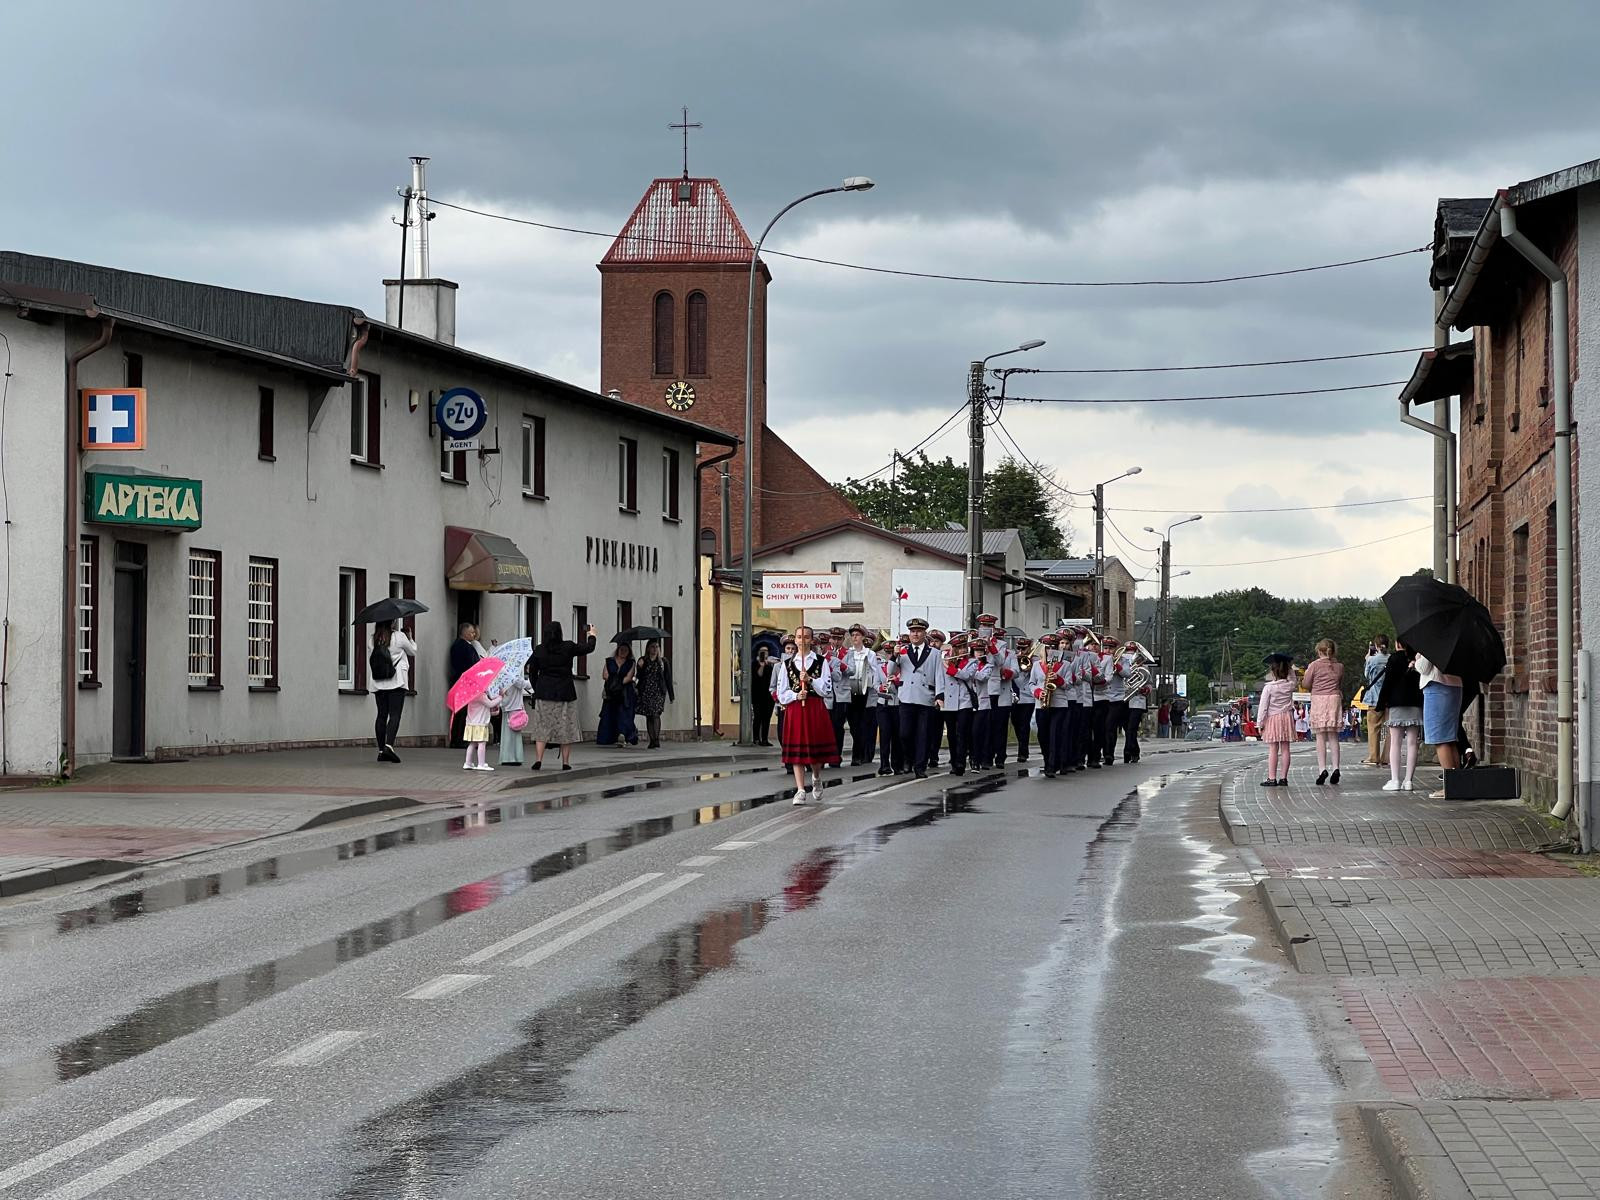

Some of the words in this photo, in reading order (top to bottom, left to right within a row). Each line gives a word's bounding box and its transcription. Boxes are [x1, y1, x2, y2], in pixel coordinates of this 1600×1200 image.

[446, 402, 474, 424] PZU
[449, 441, 473, 449] AGENT
[97, 482, 200, 521] APTEKA
